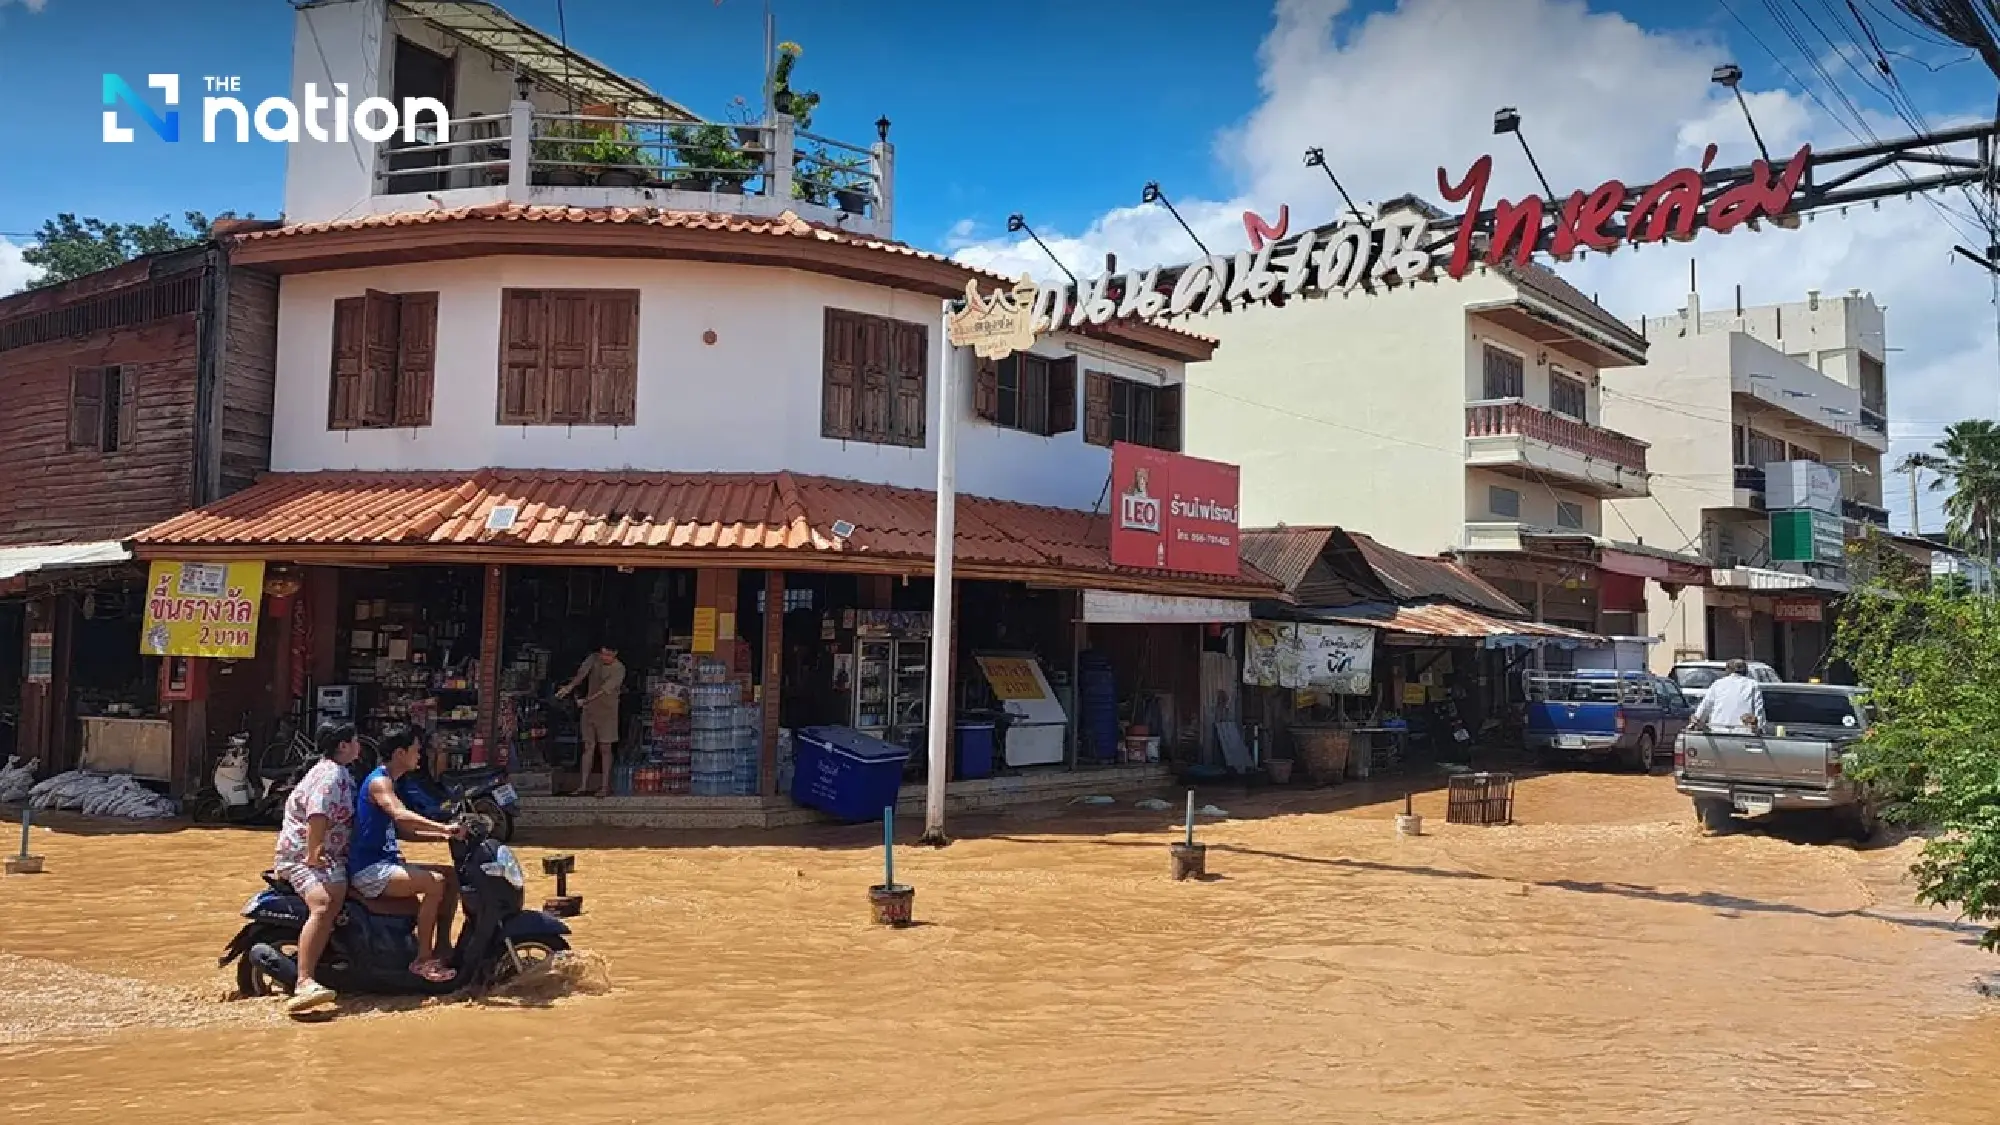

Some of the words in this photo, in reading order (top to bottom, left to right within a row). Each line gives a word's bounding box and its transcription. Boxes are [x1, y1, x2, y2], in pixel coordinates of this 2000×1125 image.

[1437, 143, 1811, 279] ไทหล่ม
[1125, 499, 1156, 524] LEO
[199, 626, 209, 645] 2
[215, 628, 249, 646] บาท
